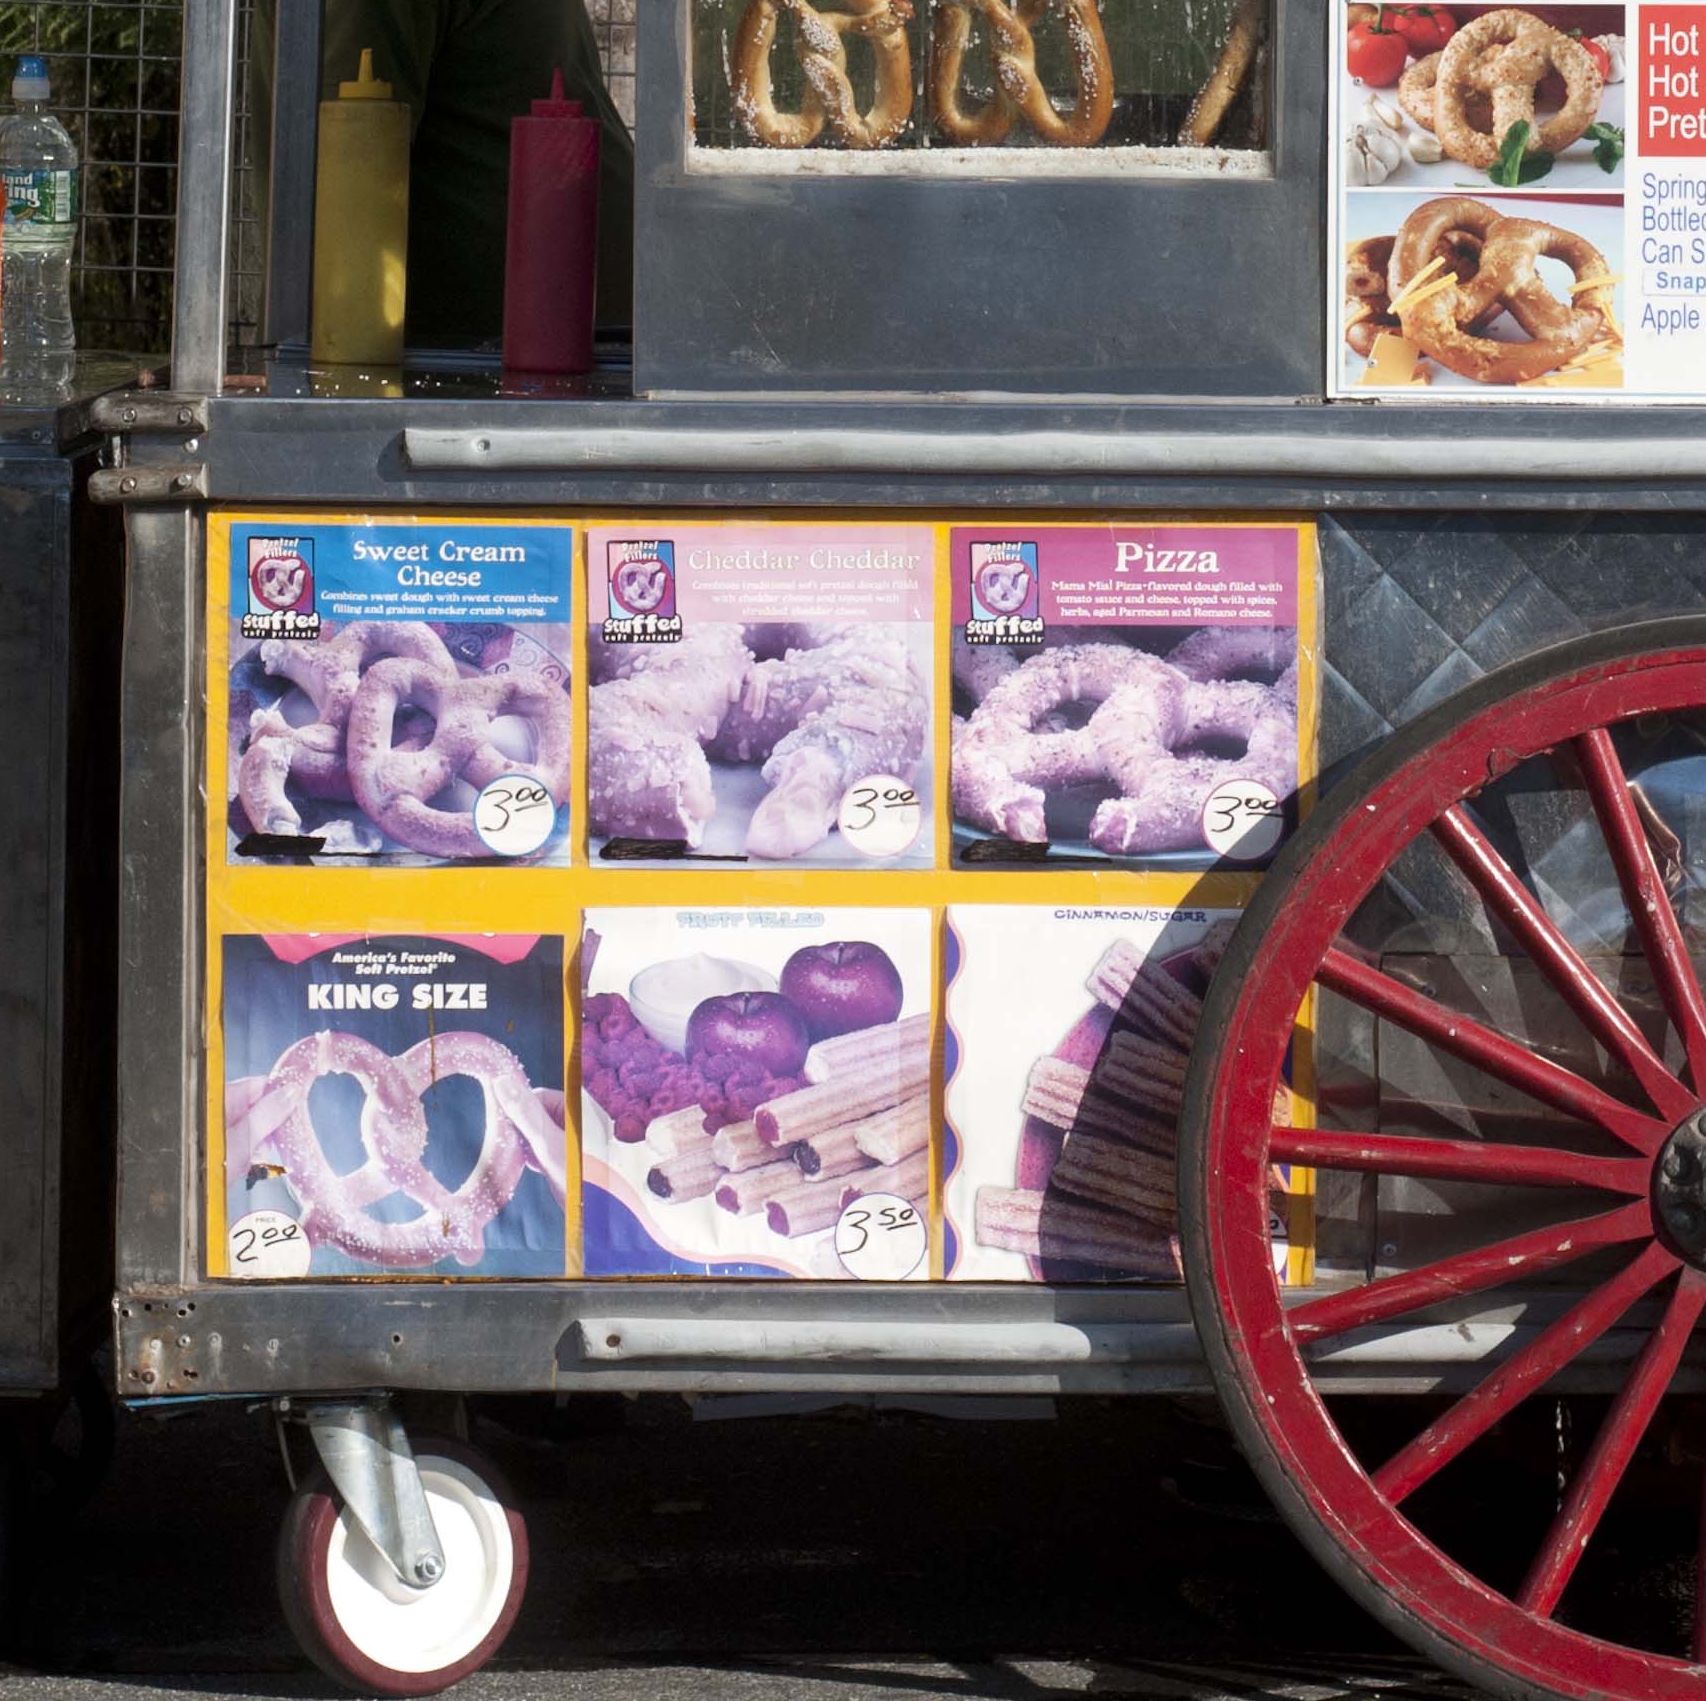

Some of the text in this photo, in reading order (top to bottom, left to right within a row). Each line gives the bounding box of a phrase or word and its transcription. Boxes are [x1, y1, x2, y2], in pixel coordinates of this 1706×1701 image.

[1649, 22, 1699, 56] Hot
[1649, 64, 1699, 97] Hot
[1642, 238, 1683, 264] Can
[1641, 303, 1700, 335] Apple
[353, 540, 526, 562] Sweet Cream
[689, 549, 921, 570] Cheddar Cheddar
[1114, 542, 1220, 573] Pizza
[397, 565, 482, 586] Cheese
[1052, 581, 1085, 591] Mama
[1195, 581, 1227, 592] dough
[1229, 581, 1255, 591] filled
[1259, 582, 1282, 592] with
[1093, 609, 1116, 618] aged
[1119, 608, 1169, 618] Parmesan
[1172, 608, 1191, 617] and
[1054, 909, 1207, 922] CINNAMON/SUGAR
[332, 952, 456, 963] America's Favorite
[356, 964, 383, 974] Soft
[308, 983, 487, 1010] KING SIZE
